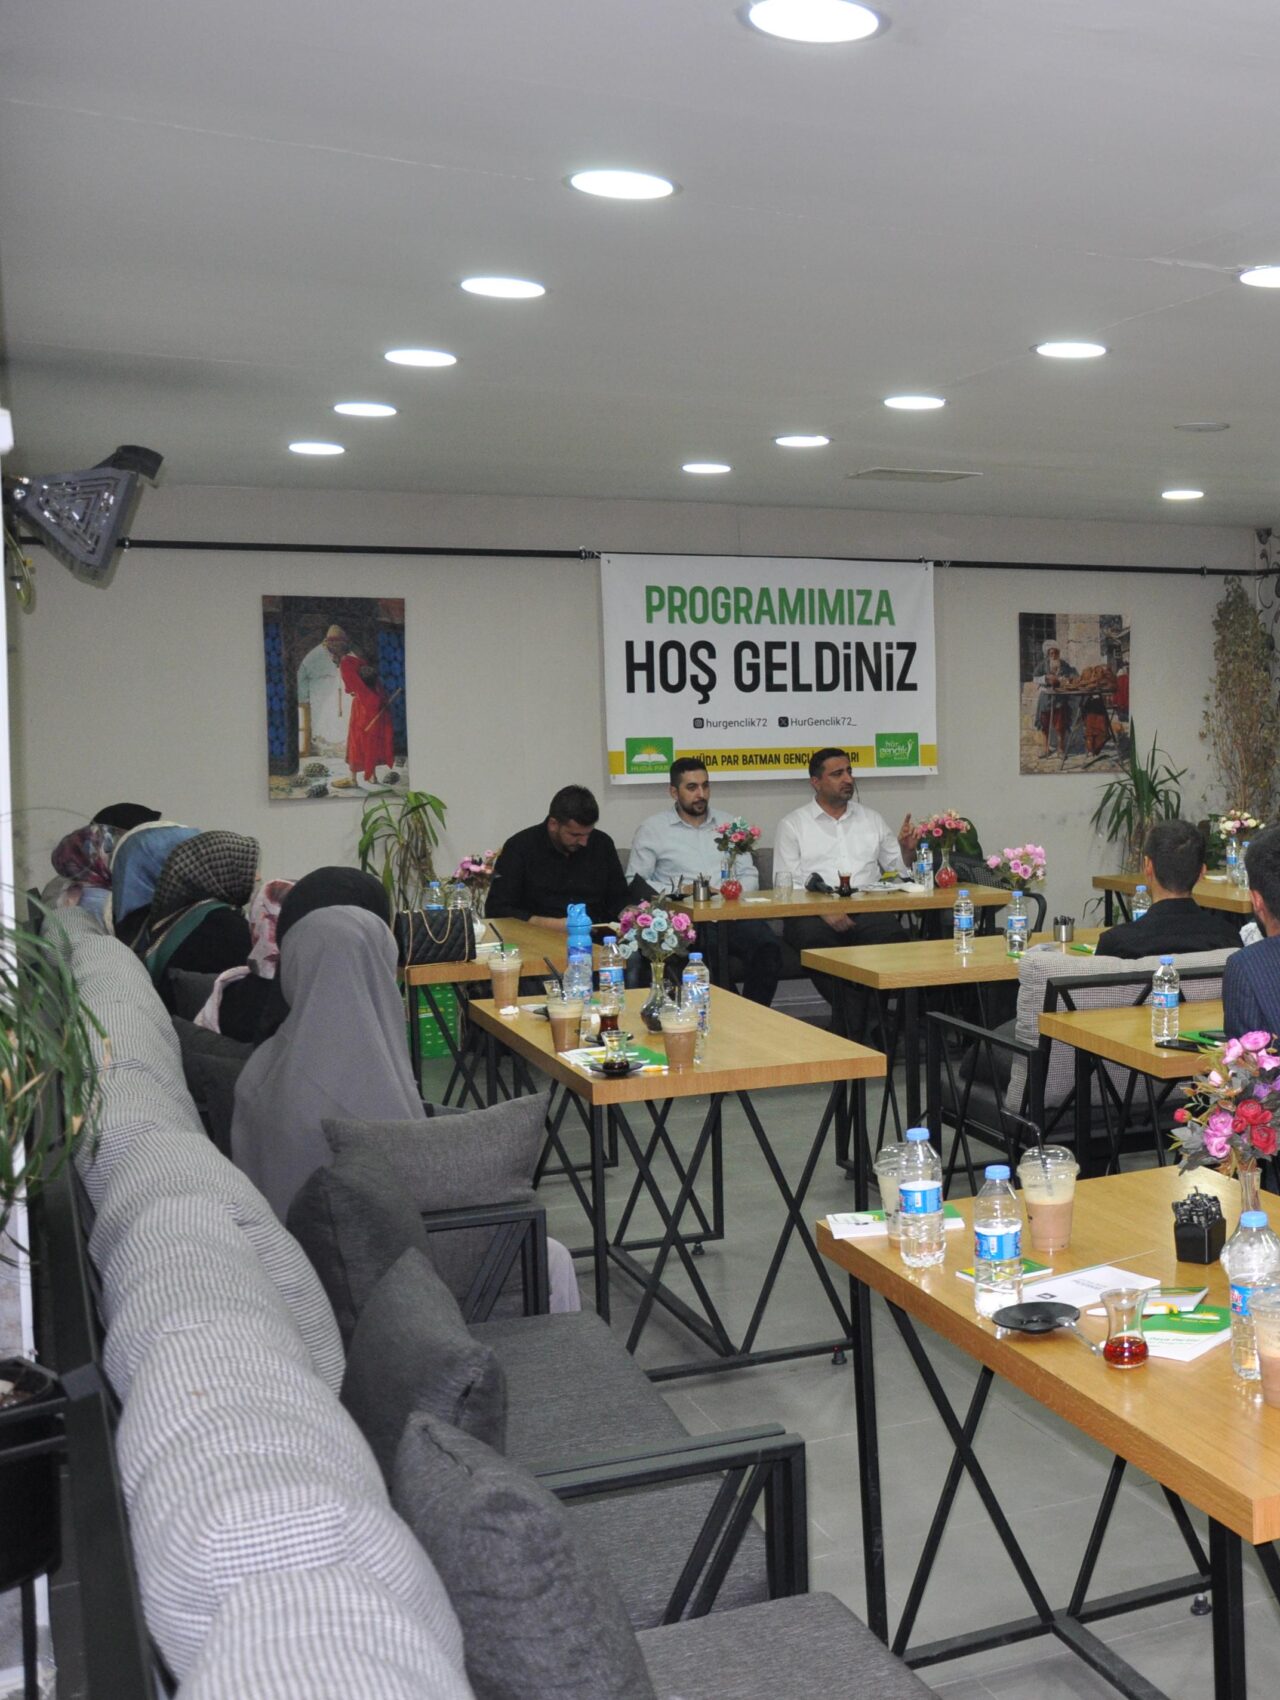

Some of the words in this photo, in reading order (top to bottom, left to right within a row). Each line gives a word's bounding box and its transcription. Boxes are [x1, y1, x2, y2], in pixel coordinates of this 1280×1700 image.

[645, 585, 896, 626] PROGRAMIMIZA
[625, 640, 717, 704] HOŞ
[706, 718, 768, 730] hurgenclik72
[721, 754, 739, 766] PAR
[742, 753, 781, 766] BATMAN
